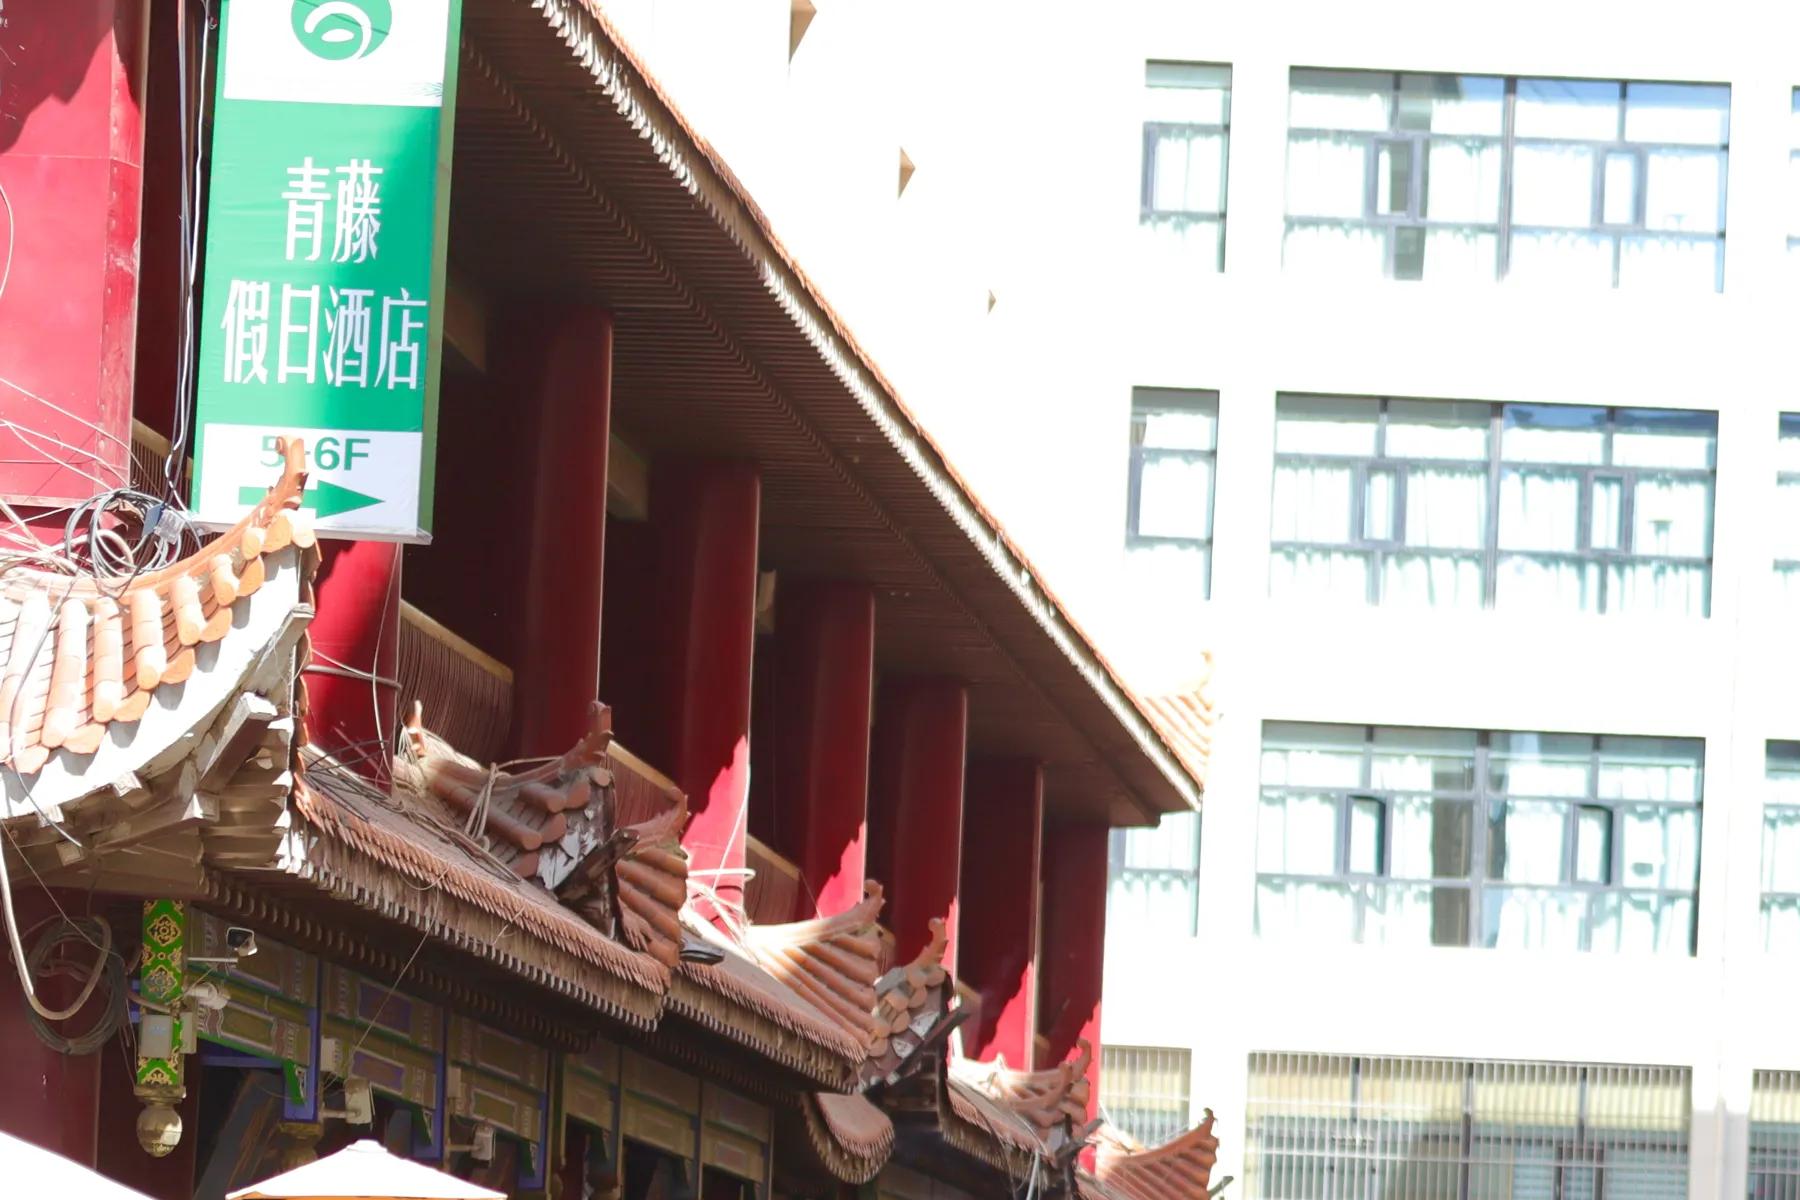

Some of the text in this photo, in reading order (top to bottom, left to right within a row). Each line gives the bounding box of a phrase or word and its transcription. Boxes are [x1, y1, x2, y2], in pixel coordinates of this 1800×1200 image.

[281, 156, 384, 264] 青藤
[220, 279, 428, 391] 假日酒店
